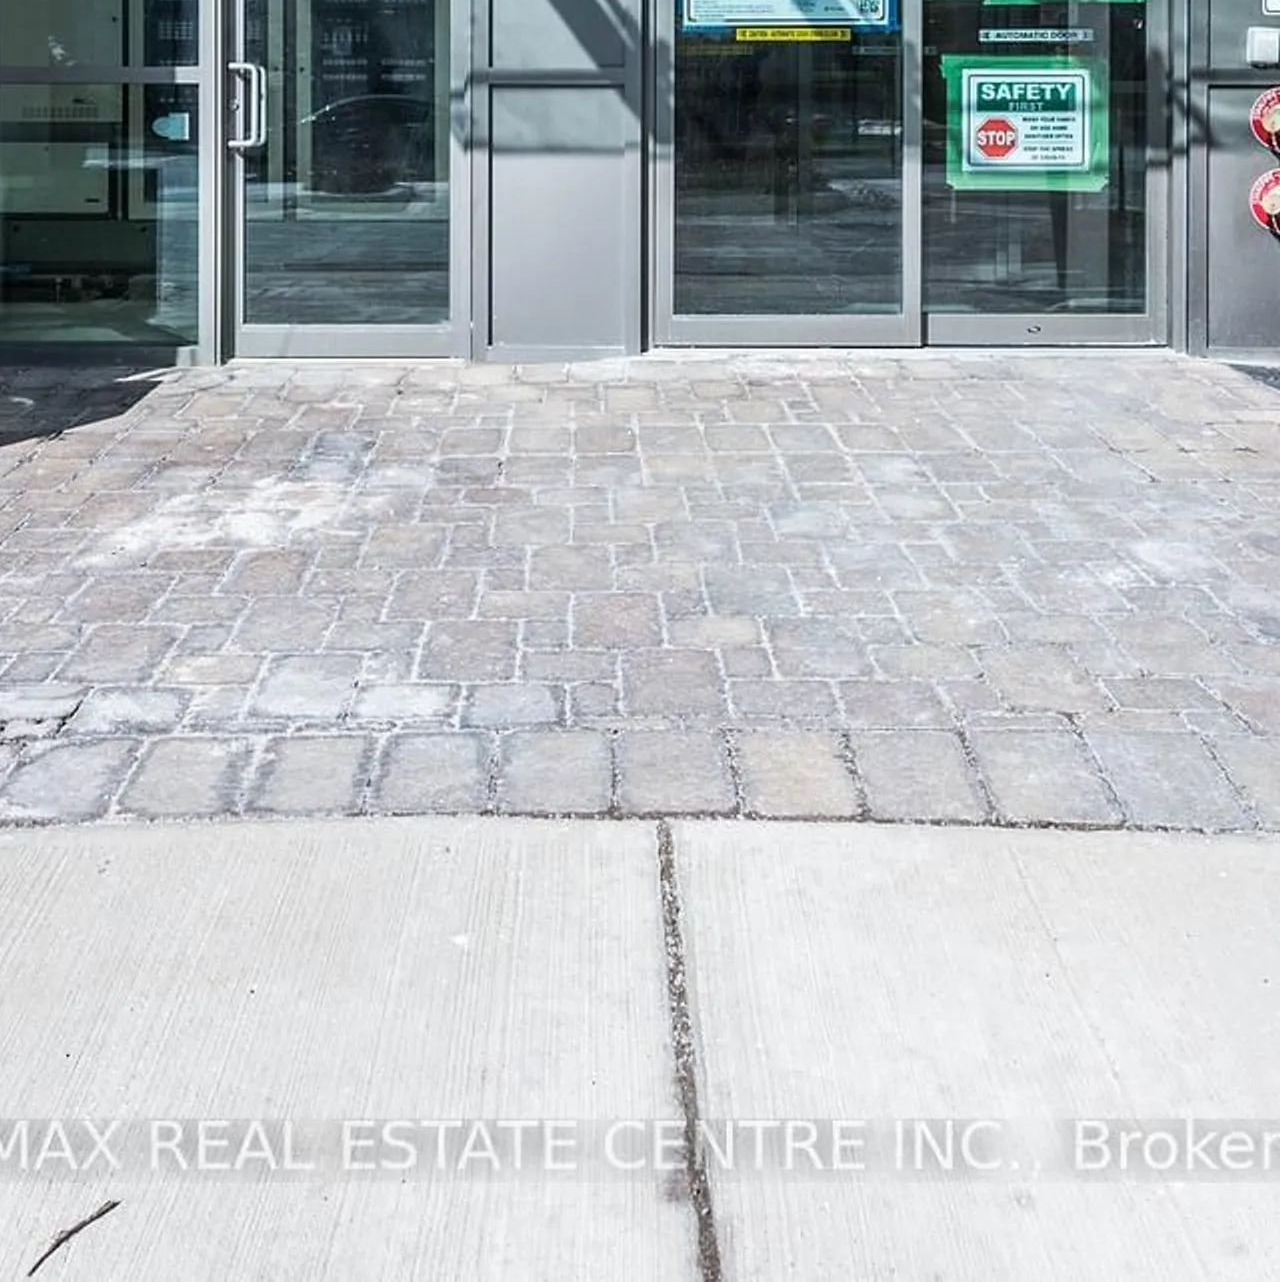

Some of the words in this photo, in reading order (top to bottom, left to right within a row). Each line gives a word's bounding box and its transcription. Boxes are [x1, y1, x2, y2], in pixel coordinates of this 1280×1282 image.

[995, 30, 1049, 39] AUTOMATIC
[1050, 30, 1077, 39] DOOR
[981, 83, 1072, 100] SAFETY
[1008, 102, 1045, 111] FIRST
[978, 130, 1015, 145] STOP
